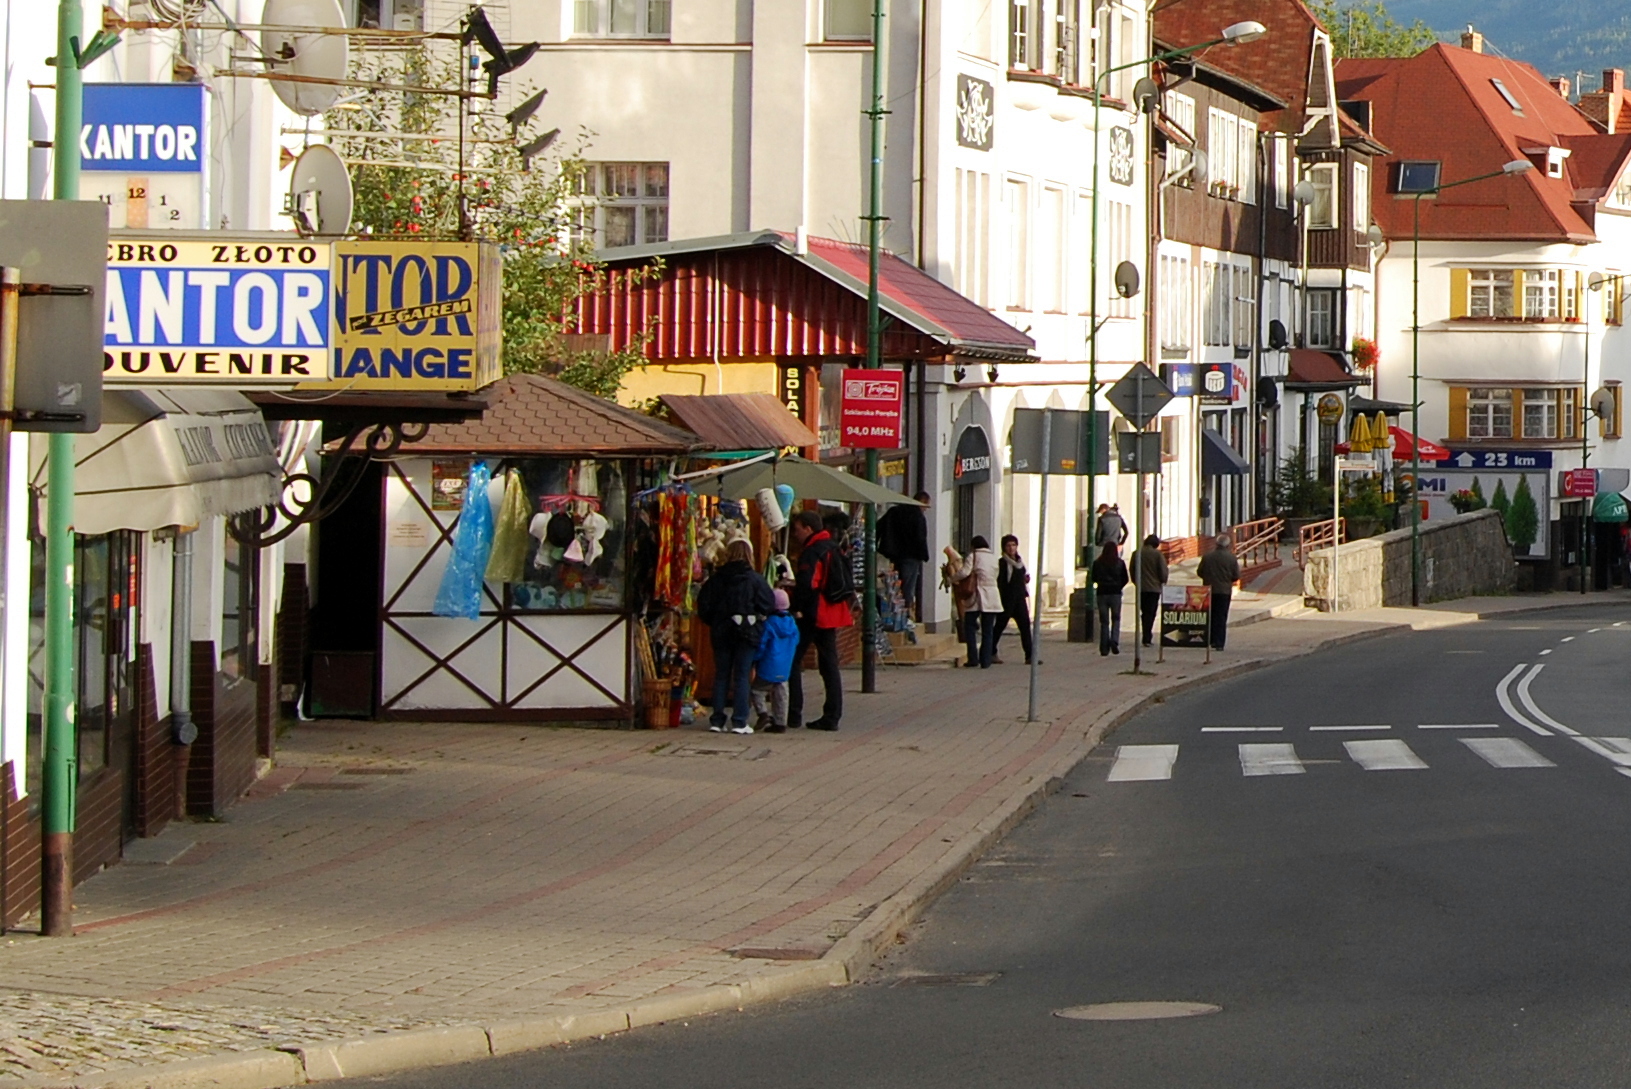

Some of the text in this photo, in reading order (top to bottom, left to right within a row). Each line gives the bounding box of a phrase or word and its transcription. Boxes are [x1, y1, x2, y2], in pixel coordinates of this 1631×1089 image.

[128, 188, 146, 199] 12
[212, 245, 316, 263] ZŁOTO
[371, 300, 469, 327] ZEGAREM
[870, 426, 895, 437] MHz
[1484, 453, 1536, 467] 23 km
[1163, 611, 1207, 625] SOLARIUM
